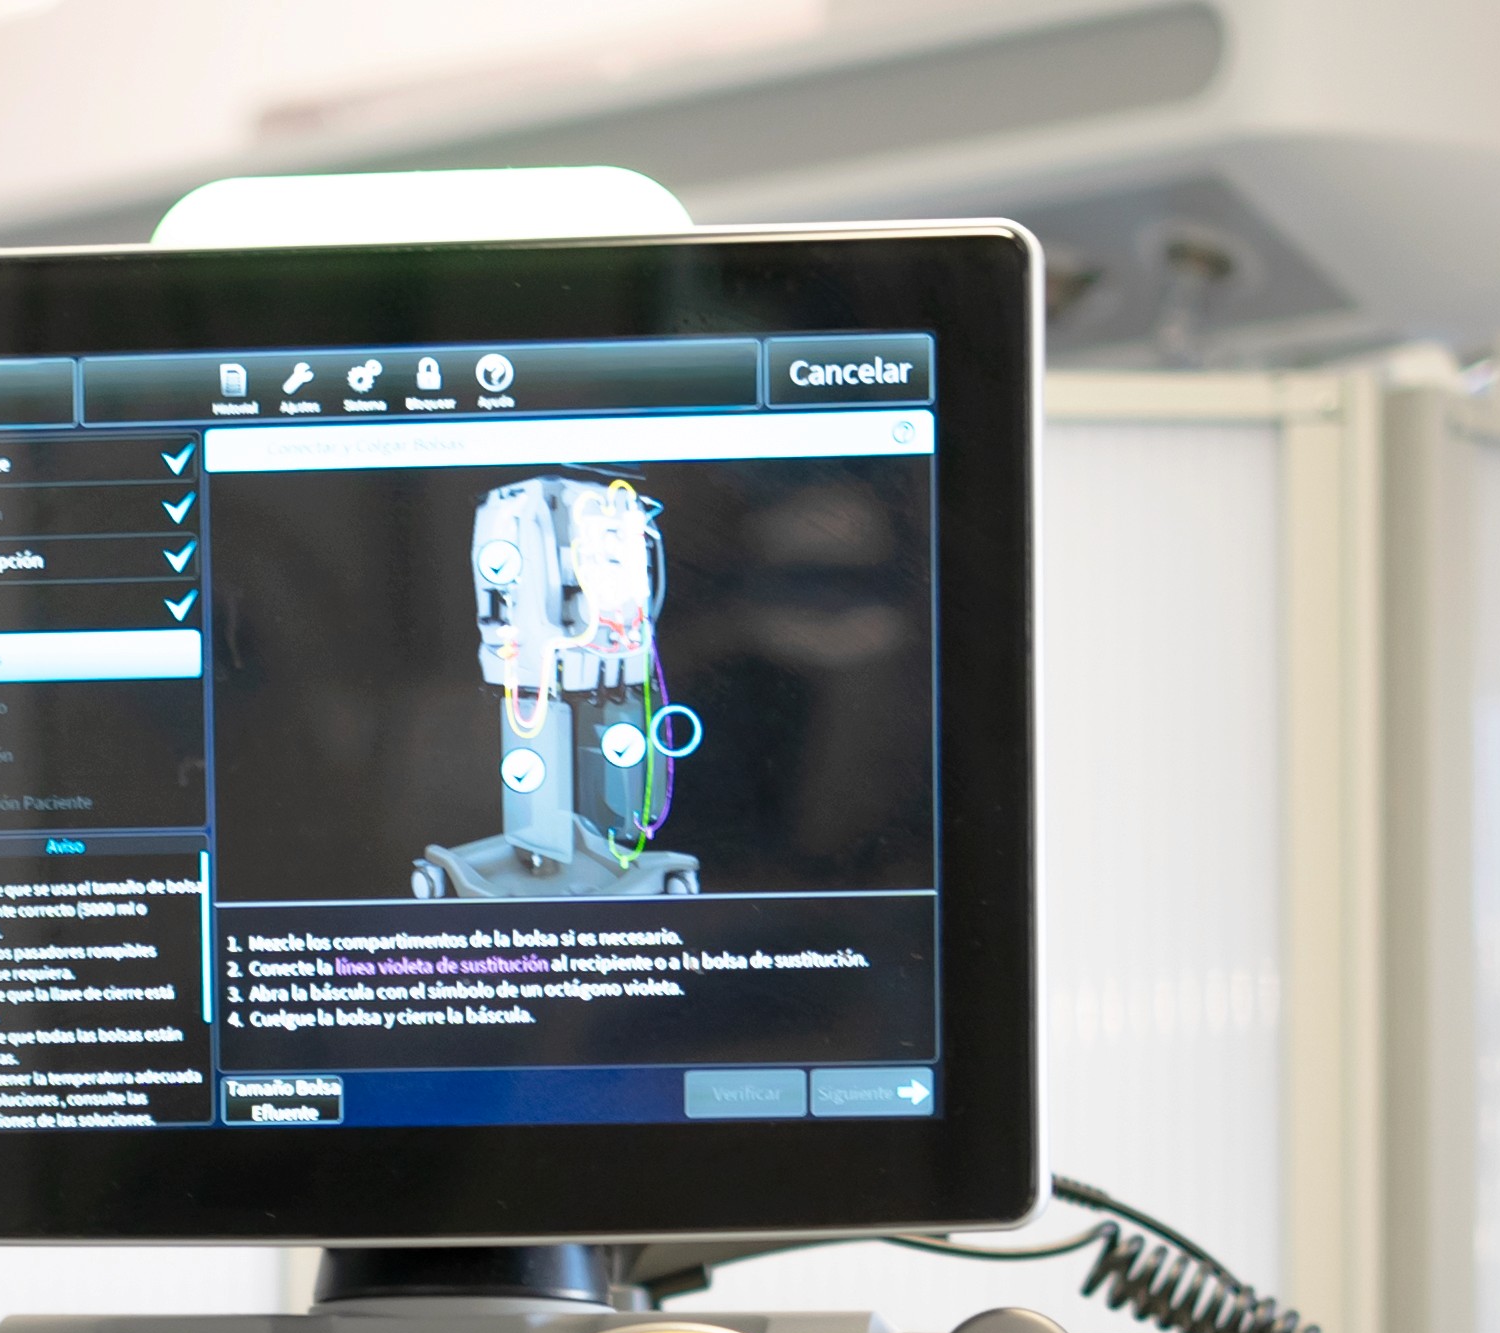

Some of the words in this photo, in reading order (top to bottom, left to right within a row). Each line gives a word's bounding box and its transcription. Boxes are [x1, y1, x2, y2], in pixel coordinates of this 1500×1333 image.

[789, 355, 913, 386] Cancelar
[23, 794, 93, 811] Paciente
[45, 837, 86, 854] Aviso
[4, 884, 32, 900] que
[33, 884, 50, 896] se
[50, 883, 77, 896] usa
[77, 881, 91, 895] el
[92, 879, 145, 895] tamaño
[146, 879, 165, 894] de
[17, 902, 76, 918] correcto
[116, 901, 136, 916] ml
[227, 936, 243, 952] 1.
[249, 933, 305, 952] Mezcle
[306, 933, 332, 951] los
[332, 932, 468, 954] compartimentos
[469, 930, 492, 948] de
[494, 930, 510, 948] la
[513, 929, 558, 947] bolsa
[560, 929, 575, 947] si
[577, 932, 597, 946] es
[599, 928, 683, 946] necesario.
[13, 944, 86, 963] pasadores
[86, 943, 157, 961] rompibles
[227, 961, 243, 977] 2.
[248, 959, 315, 977] Conecte
[317, 958, 333, 976] la
[336, 957, 376, 976] línea
[377, 956, 434, 975] violeta
[436, 956, 458, 974] de
[460, 954, 549, 973] sustitución
[551, 954, 568, 972] al
[570, 953, 653, 975] recipiente
[654, 957, 667, 971] o
[668, 956, 680, 970] a
[683, 952, 700, 970] la
[702, 951, 748, 970] bolsa
[750, 950, 773, 969] de
[774, 948, 869, 969] sustitución.
[6, 989, 34, 1005] que
[34, 987, 50, 1002] la
[83, 986, 102, 1001] de
[103, 985, 144, 1000] cierre
[144, 984, 175, 1000] está
[227, 986, 244, 1002] 3.
[249, 983, 289, 1002] Abra
[291, 983, 308, 1001] la
[310, 982, 375, 1001] báscula
[376, 986, 408, 1000] con
[409, 981, 425, 999] el
[427, 980, 495, 999] símbolo
[496, 980, 519, 998] de
[520, 984, 543, 998] un
[543, 978, 622, 1001] octágono
[623, 977, 684, 996] violeta.
[227, 1011, 244, 1028] 4.
[250, 1009, 316, 1031] Cuelgue
[317, 1008, 334, 1026] la
[336, 1007, 382, 1026] bolsa
[383, 1012, 396, 1029] y
[396, 1008, 445, 1025] cierre
[447, 1006, 464, 1024] la
[466, 1005, 536, 1024] báscula.
[7, 1032, 35, 1047] que
[36, 1029, 76, 1044] todas
[76, 1028, 98, 1043] las
[98, 1028, 144, 1043] bolsas
[144, 1026, 184, 1042] están
[33, 1071, 48, 1085] la
[48, 1071, 134, 1088] temperatura
[135, 1069, 202, 1084] adecuada
[226, 1078, 294, 1097] Tamaño
[295, 1077, 342, 1096] Bolsa
[67, 1091, 126, 1106] consulte
[126, 1090, 148, 1105] las
[816, 1086, 894, 1105] Siguiente
[37, 1113, 56, 1128] de
[56, 1112, 77, 1128] las
[251, 1103, 320, 1122] Efluente
